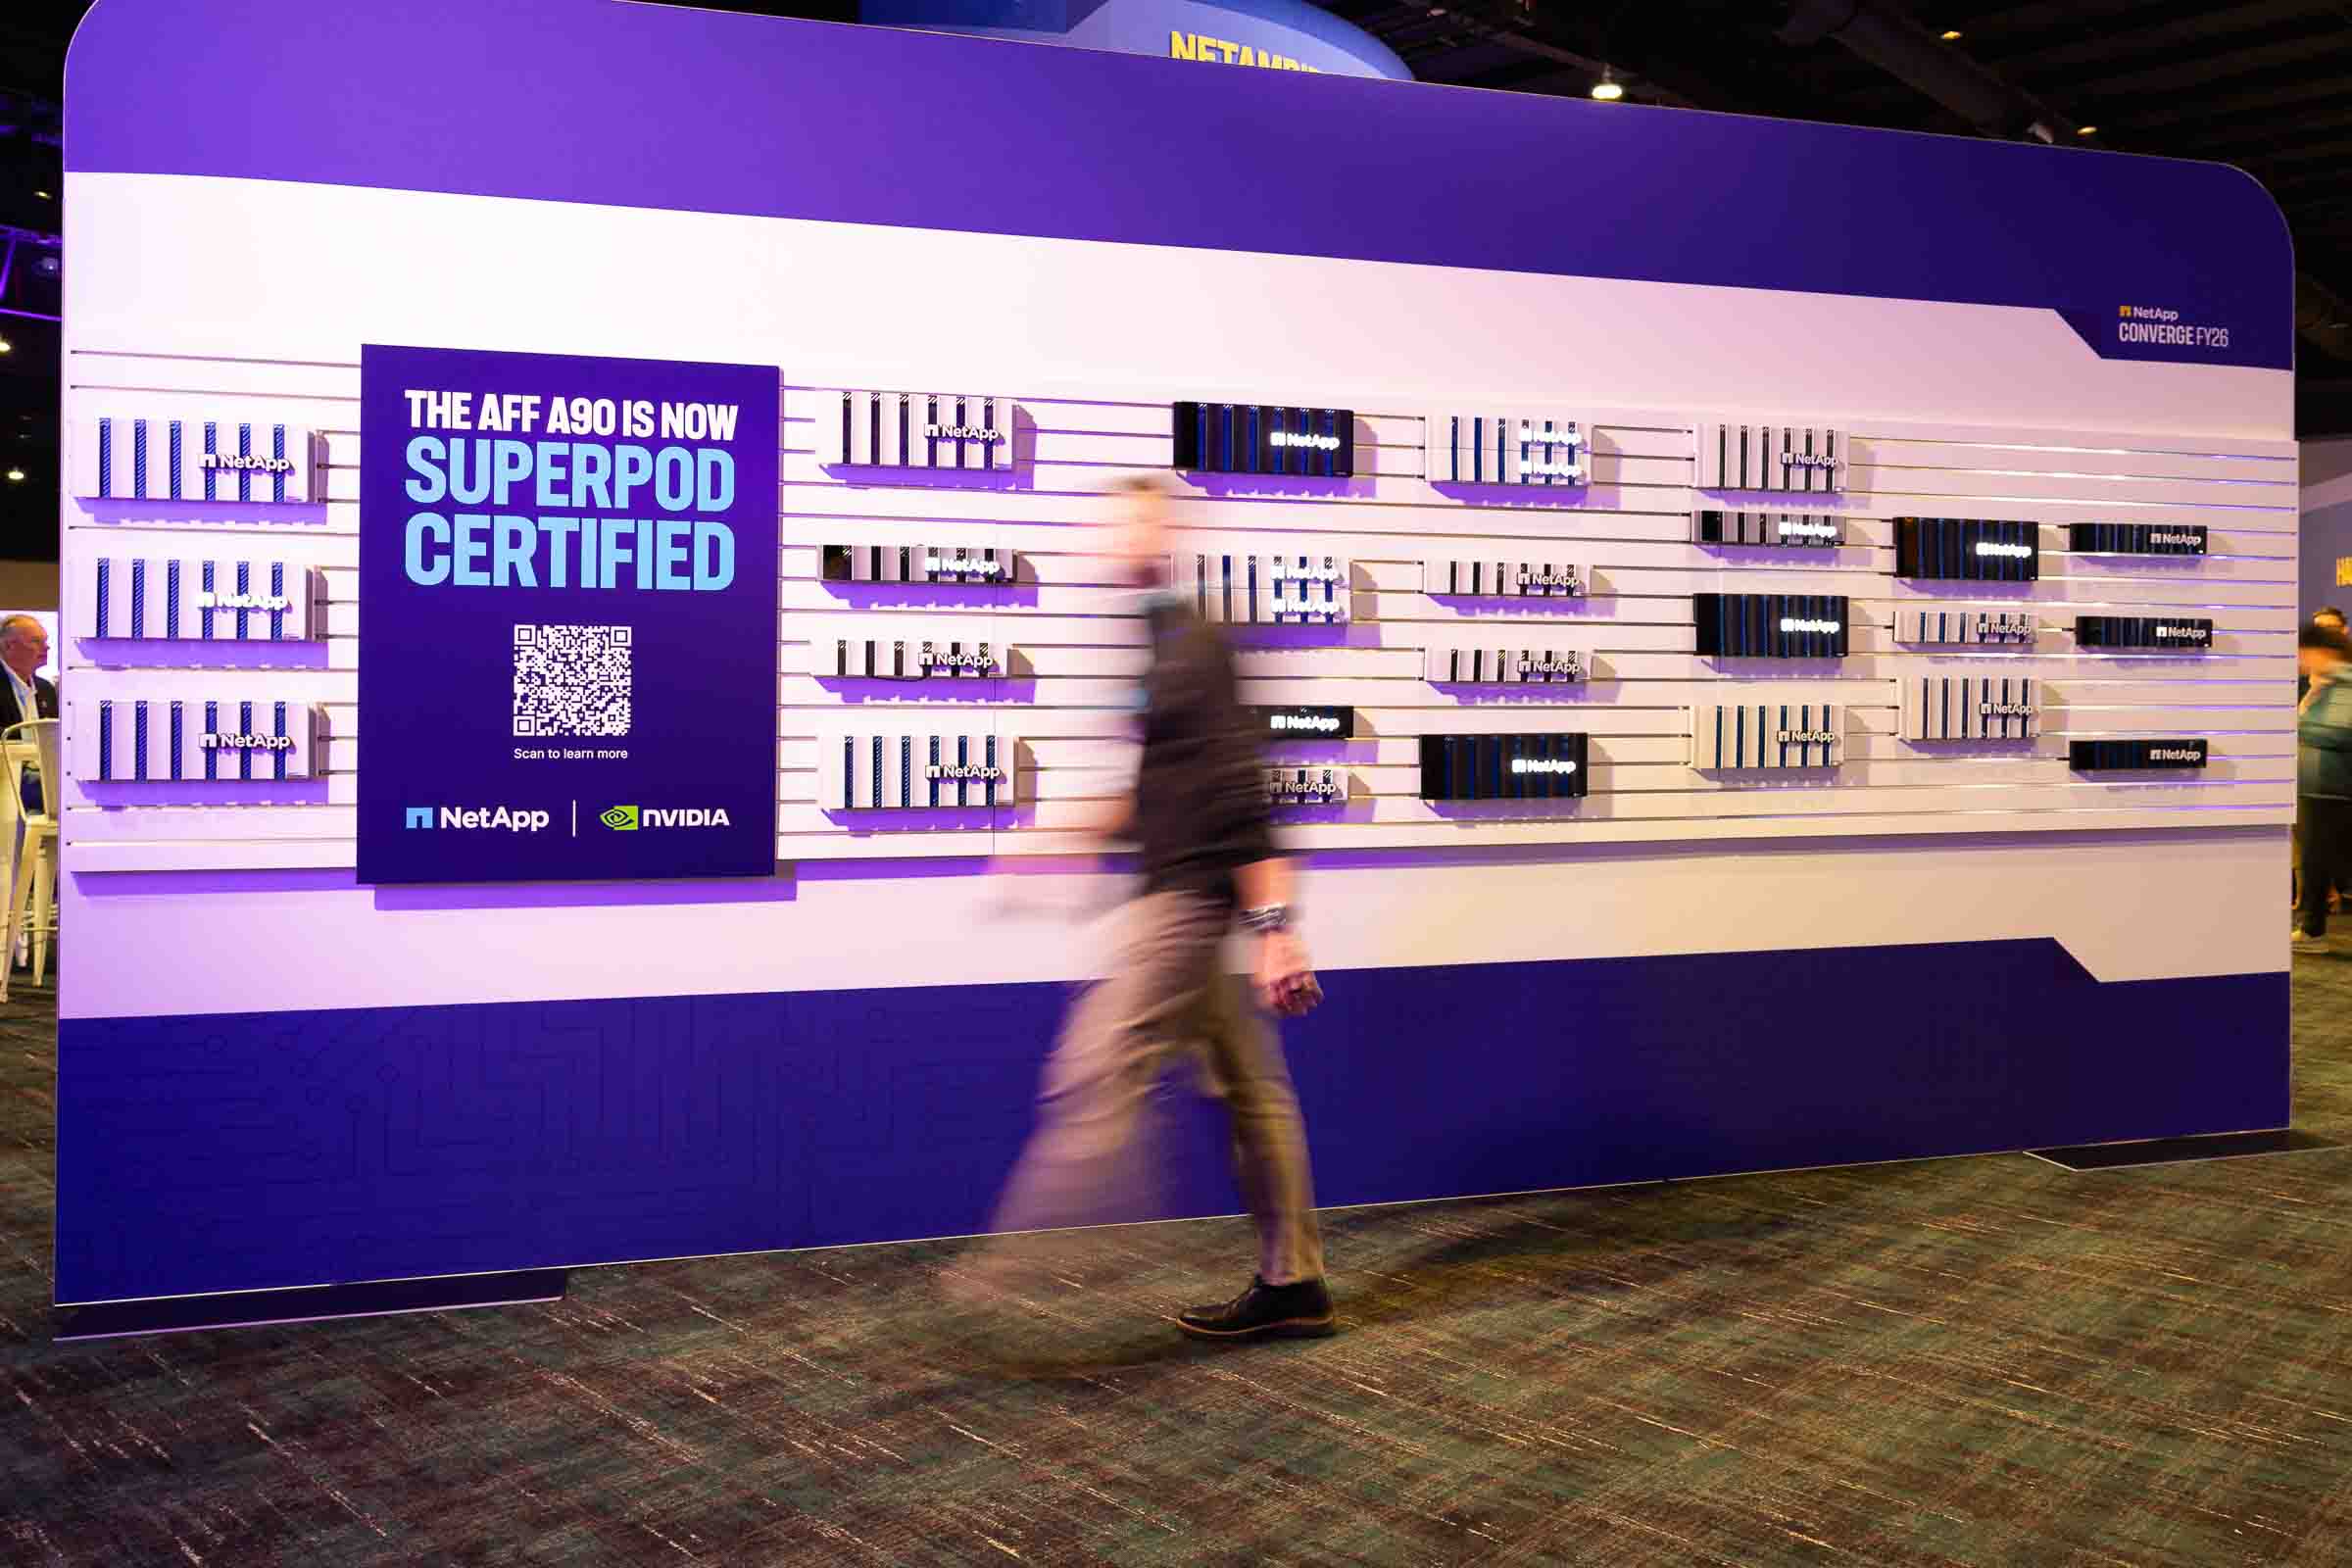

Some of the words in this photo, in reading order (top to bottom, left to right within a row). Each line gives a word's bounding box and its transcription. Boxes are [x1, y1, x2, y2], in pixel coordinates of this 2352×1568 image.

[2133, 306, 2179, 321] NetApp
[2118, 321, 2193, 346] CONVERGE
[2195, 325, 2230, 347] FY26
[404, 389, 472, 430] THE
[477, 392, 541, 433] AFF
[546, 396, 615, 437] A90
[622, 400, 654, 438] IS
[661, 402, 739, 441] NOW
[942, 424, 1000, 440] NetApp
[1286, 431, 1341, 450] NetApp
[220, 454, 290, 472] NetApp
[1795, 453, 1838, 467] NetApp
[405, 435, 735, 513] SUPERPOD
[2162, 533, 2202, 546] NetApp
[404, 512, 735, 592] CERTIFIED
[942, 557, 1001, 574] NetApp
[1532, 573, 1580, 586] NetApp
[1990, 622, 2032, 635] NetApp
[2168, 626, 2206, 639] NetApp
[936, 653, 994, 667] NetApp
[1533, 661, 1581, 674] NetApp
[1993, 703, 2034, 715] NetApp
[1287, 714, 1341, 732] NetApp
[221, 733, 291, 750] NetApp
[1791, 729, 1836, 744] NetApp
[514, 747, 545, 760] Scan
[548, 748, 561, 760] to
[564, 747, 594, 760] learn
[597, 749, 628, 760] more
[2162, 749, 2201, 761] NetApp
[944, 763, 1001, 780] NetApp
[1285, 782, 1337, 795] NetApp
[440, 806, 550, 832] NetApp
[643, 808, 730, 827] NVIDIA
